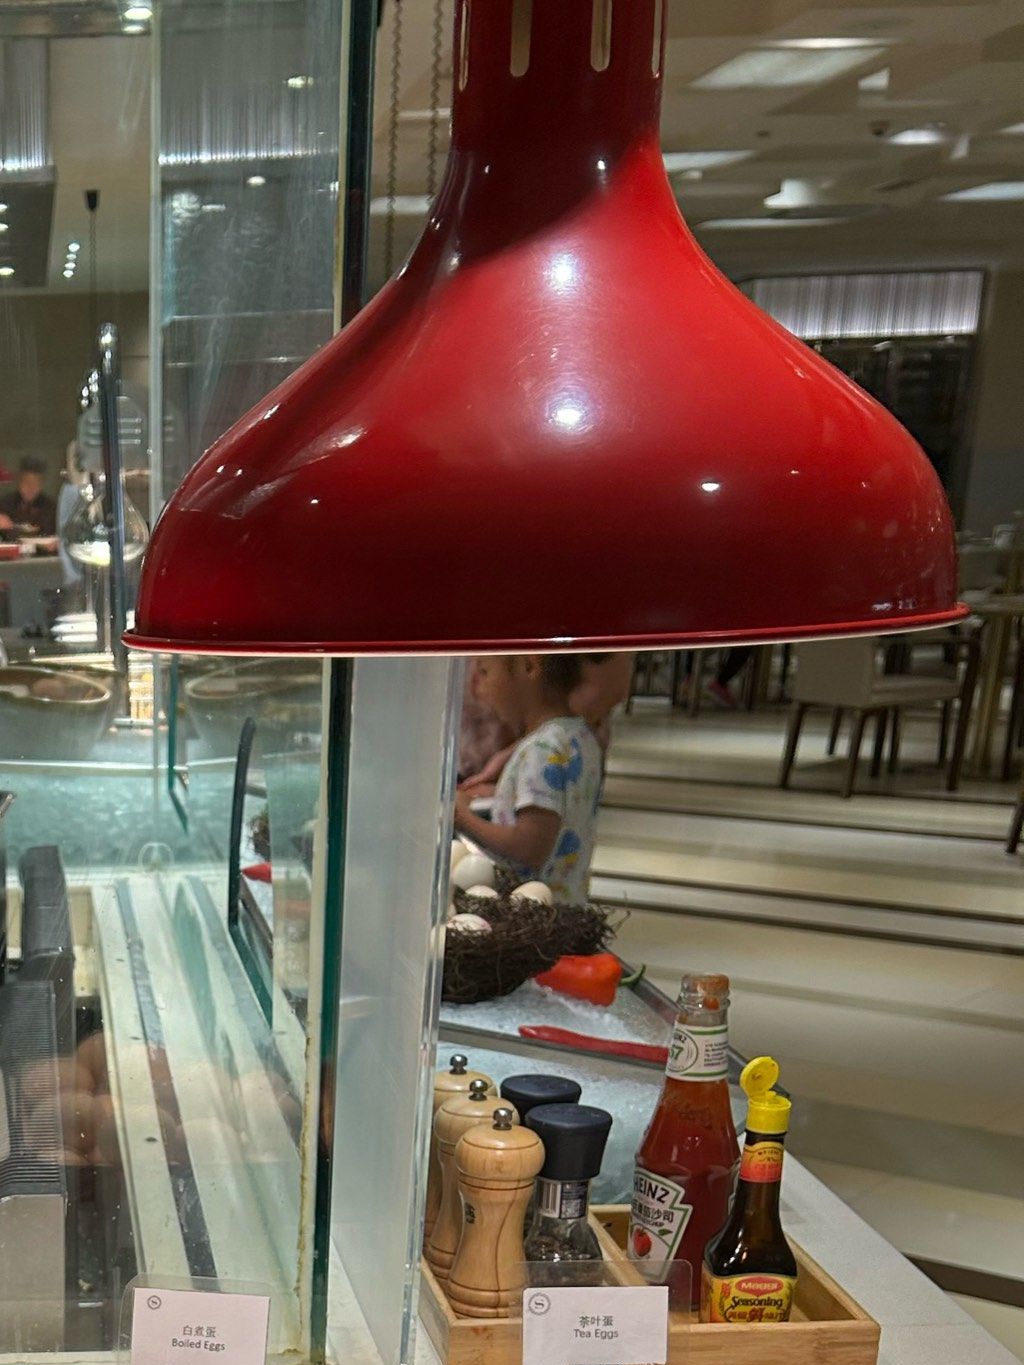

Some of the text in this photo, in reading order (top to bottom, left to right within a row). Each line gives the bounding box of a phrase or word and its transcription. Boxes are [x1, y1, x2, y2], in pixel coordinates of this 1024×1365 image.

[731, 1296, 783, 1309] Seasoning
[579, 1316, 613, 1328] 茶叶蛋
[182, 1325, 217, 1338] 白煮蛋
[574, 1329, 619, 1340] Tea Eggs
[171, 1338, 226, 1351] Boiled Eggs
